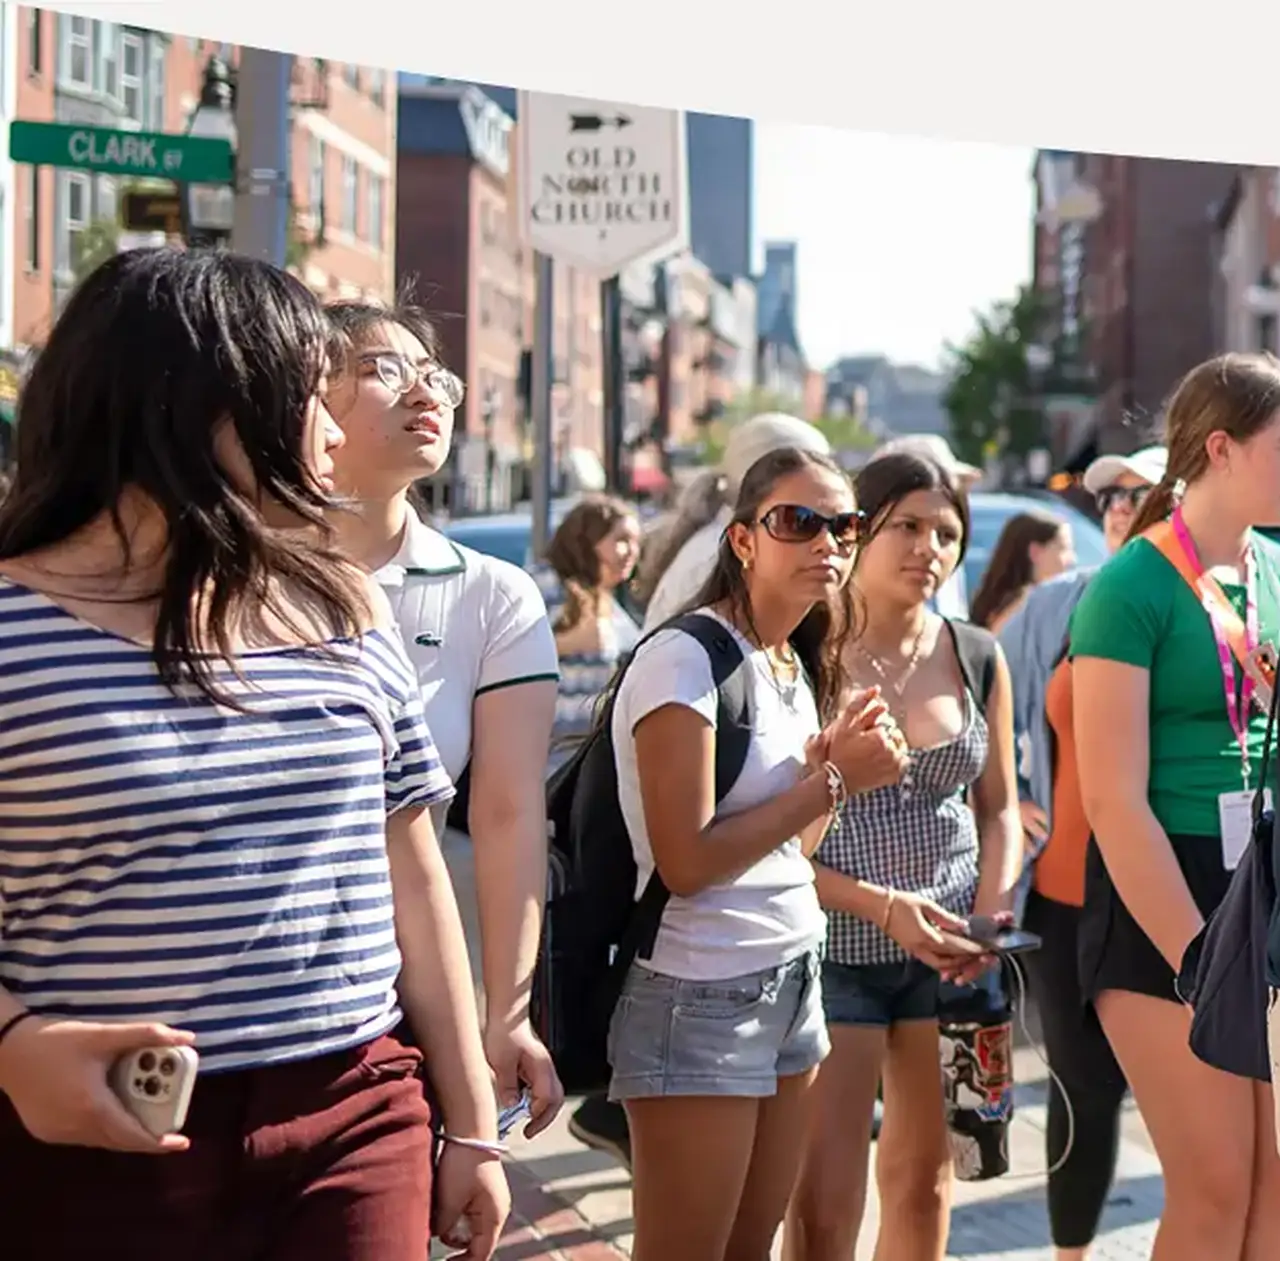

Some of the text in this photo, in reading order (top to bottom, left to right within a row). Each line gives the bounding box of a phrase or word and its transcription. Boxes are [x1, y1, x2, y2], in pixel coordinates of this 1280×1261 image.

[68, 131, 156, 168] CLARK
[566, 147, 637, 169] OLD
[541, 172, 661, 196] NORTH
[531, 199, 671, 225] CHURCH
